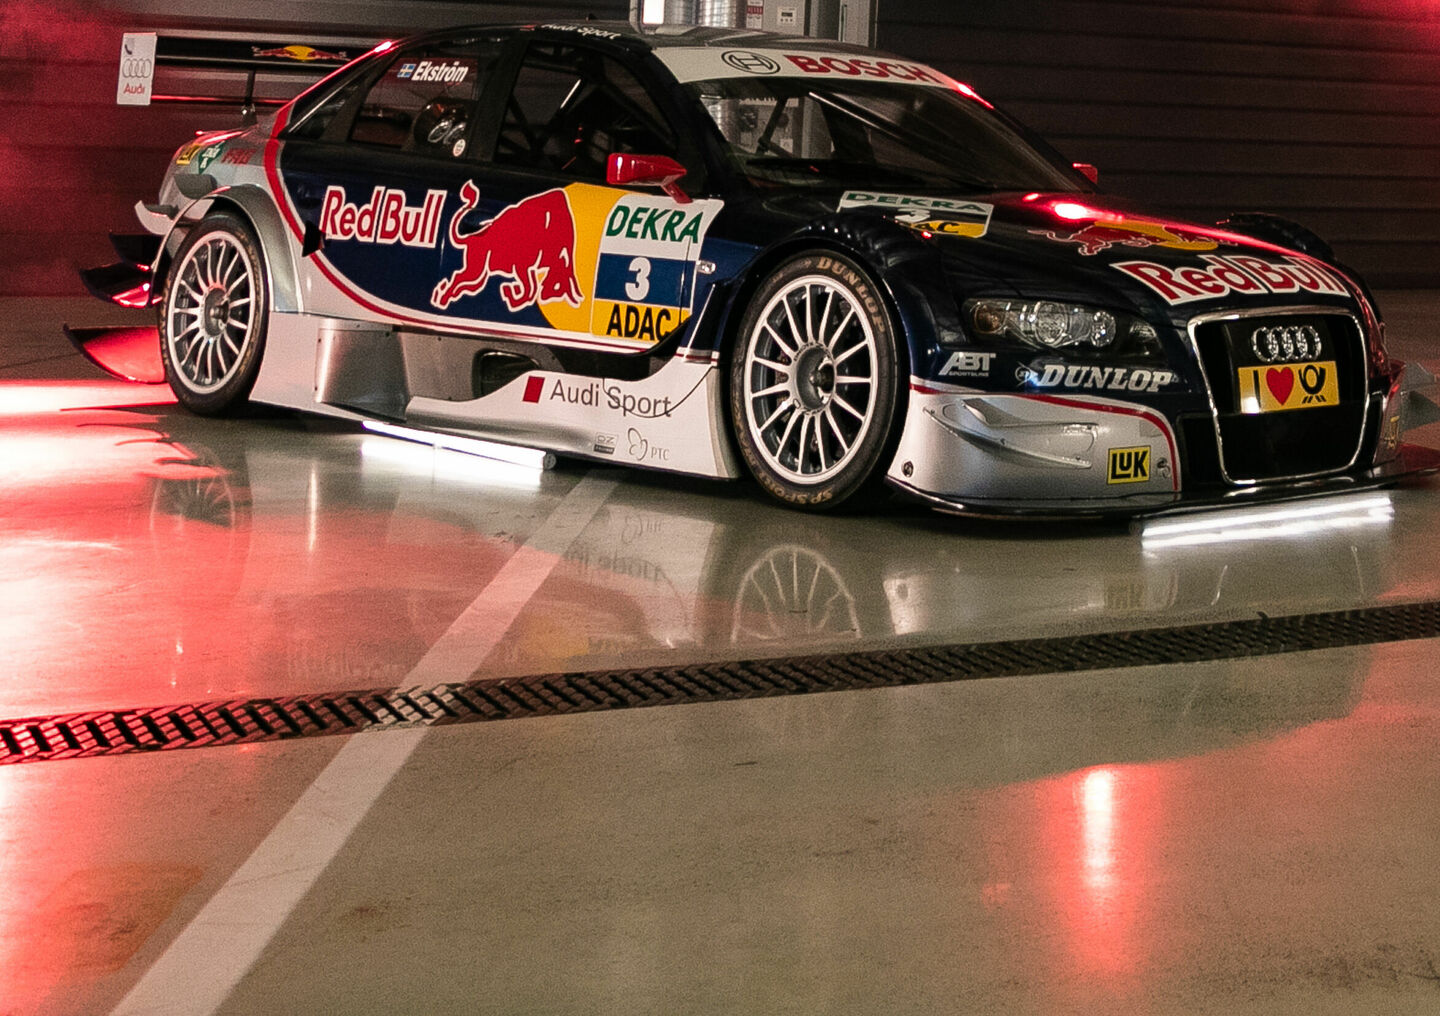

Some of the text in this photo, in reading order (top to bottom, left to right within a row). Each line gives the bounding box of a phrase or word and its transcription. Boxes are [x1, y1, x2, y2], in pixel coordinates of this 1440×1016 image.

[412, 60, 469, 82] Ekström
[783, 54, 943, 83] BOSCH
[123, 83, 145, 95] Audi
[846, 193, 988, 213] DEKRA
[606, 204, 704, 244] DEKRA
[625, 256, 651, 301] 3
[606, 304, 671, 342] ADAC
[938, 351, 996, 375] ABT
[1037, 364, 1173, 392] DUNLOP
[550, 379, 672, 418] Audi Sport
